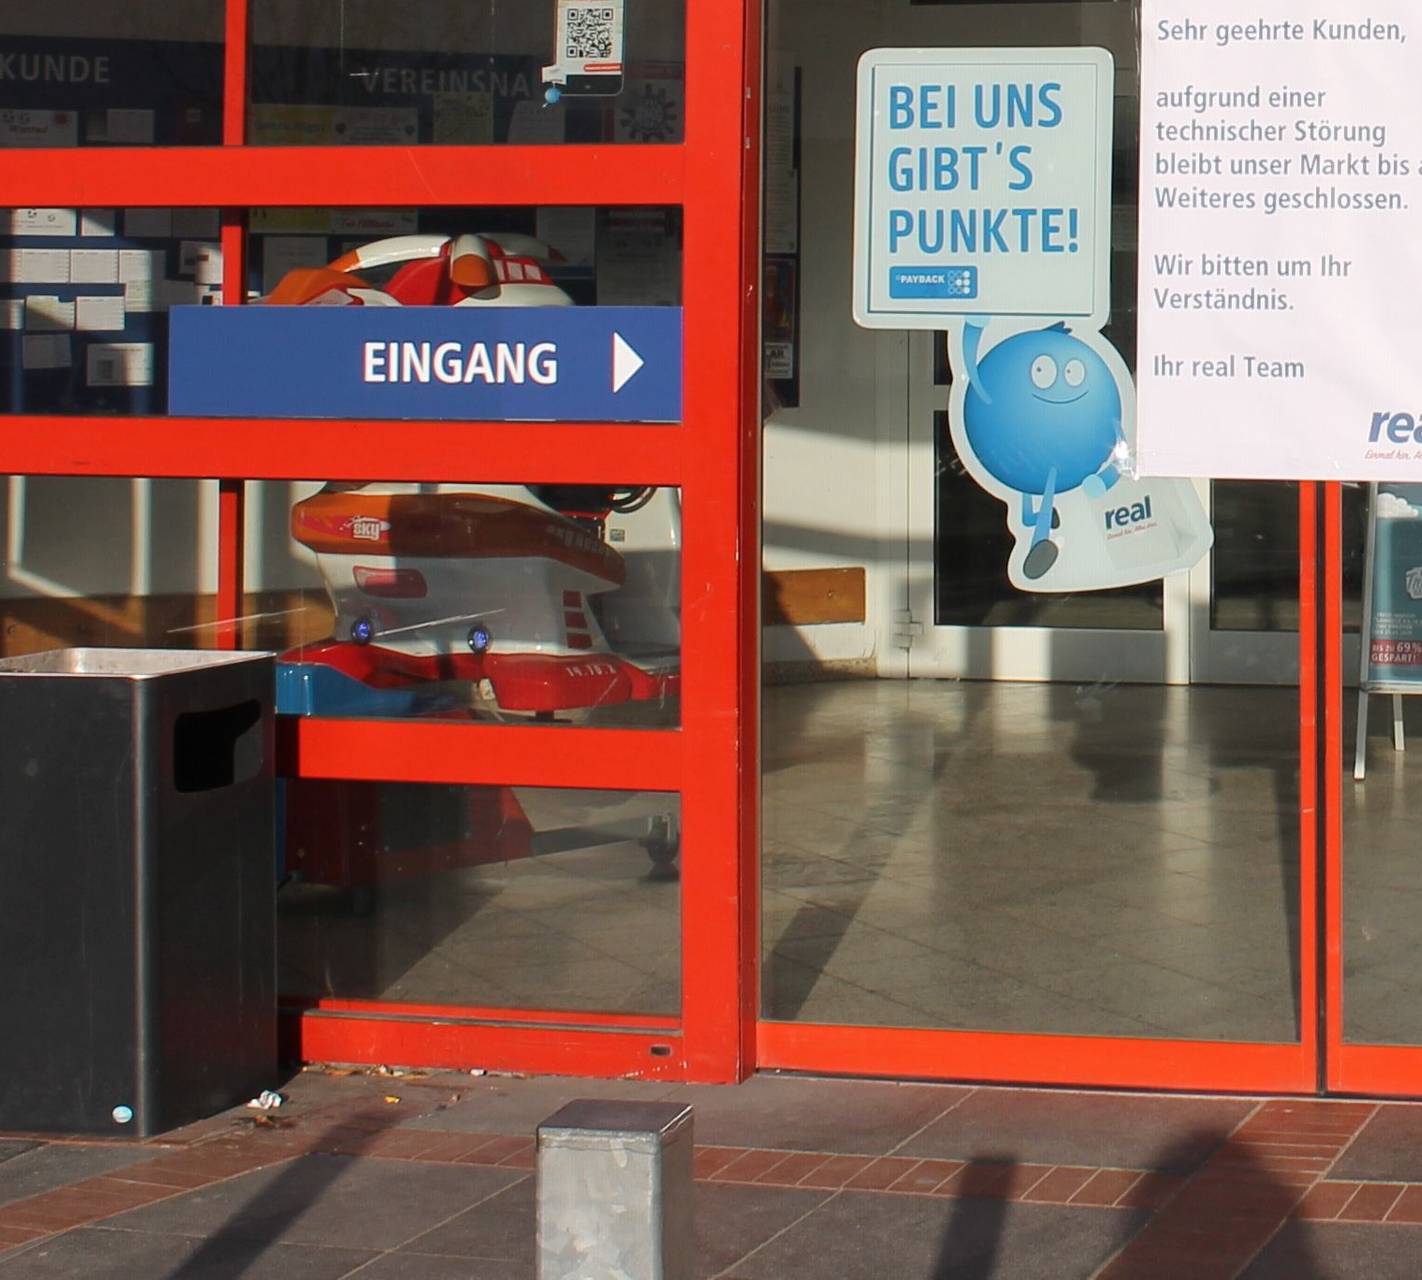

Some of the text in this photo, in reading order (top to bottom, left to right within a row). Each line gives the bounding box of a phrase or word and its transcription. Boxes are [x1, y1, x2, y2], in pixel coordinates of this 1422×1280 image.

[1157, 18, 1407, 46] Sehr geehrte Kunden,
[0, 54, 110, 83] KUNDE
[889, 82, 1063, 130] BEI UNS
[1156, 85, 1327, 113] aufgrund einer
[1156, 119, 1386, 147] technischer Störung
[888, 142, 1033, 192] GIBT'S
[1155, 153, 1222, 175] bleibt
[1230, 158, 1292, 175] unser
[1300, 154, 1370, 176] Markt
[1378, 153, 1410, 176] bis
[1155, 187, 1409, 214] Weiteres geschlossen.
[889, 207, 1079, 254] PUNKTE!
[1154, 254, 1352, 277] Wir bitten um Ihr
[1154, 288, 1295, 311] Verständnis.
[363, 342, 558, 385] EINGANG
[1154, 354, 1305, 377] Ihr real Team
[1105, 495, 1152, 530] real
